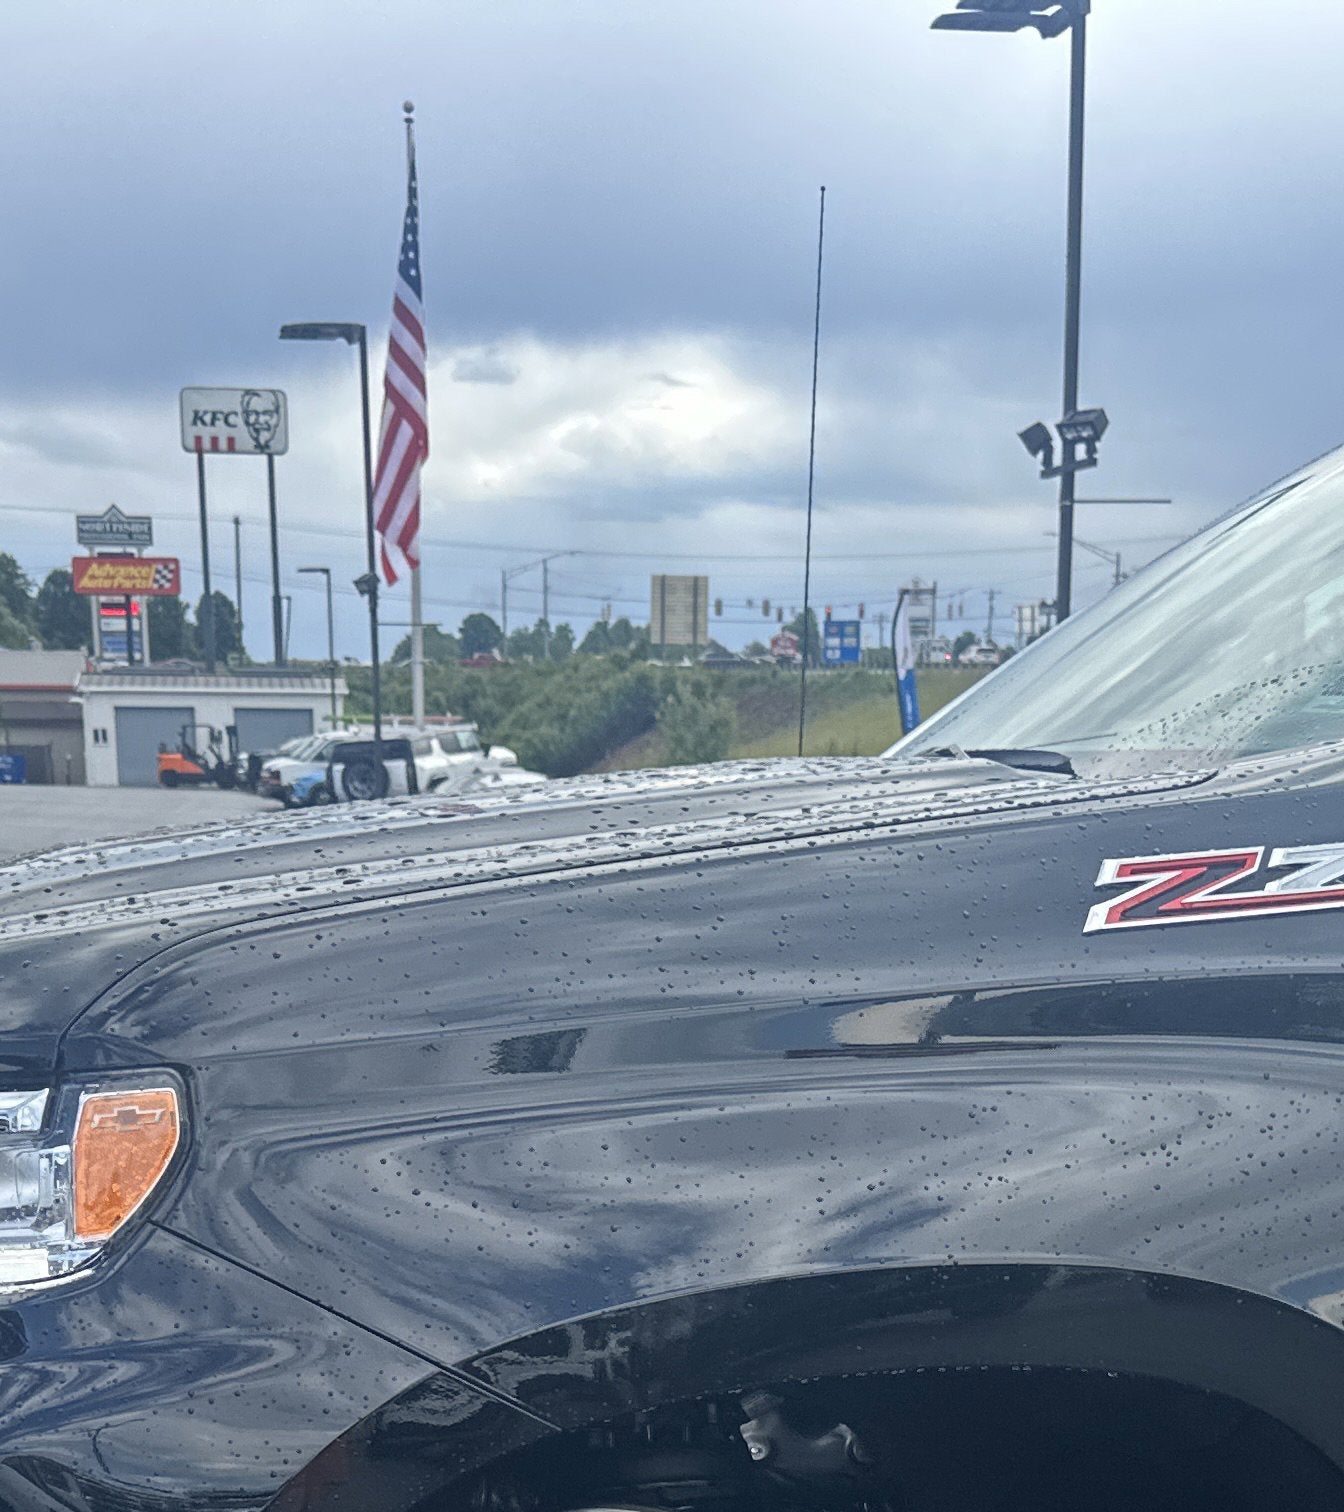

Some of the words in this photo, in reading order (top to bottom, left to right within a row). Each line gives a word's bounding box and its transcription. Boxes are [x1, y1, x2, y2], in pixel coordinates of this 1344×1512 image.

[191, 410, 238, 428] KFC
[88, 563, 151, 577] Advance
[79, 578, 112, 589] Auto
[113, 578, 150, 589] Parts
